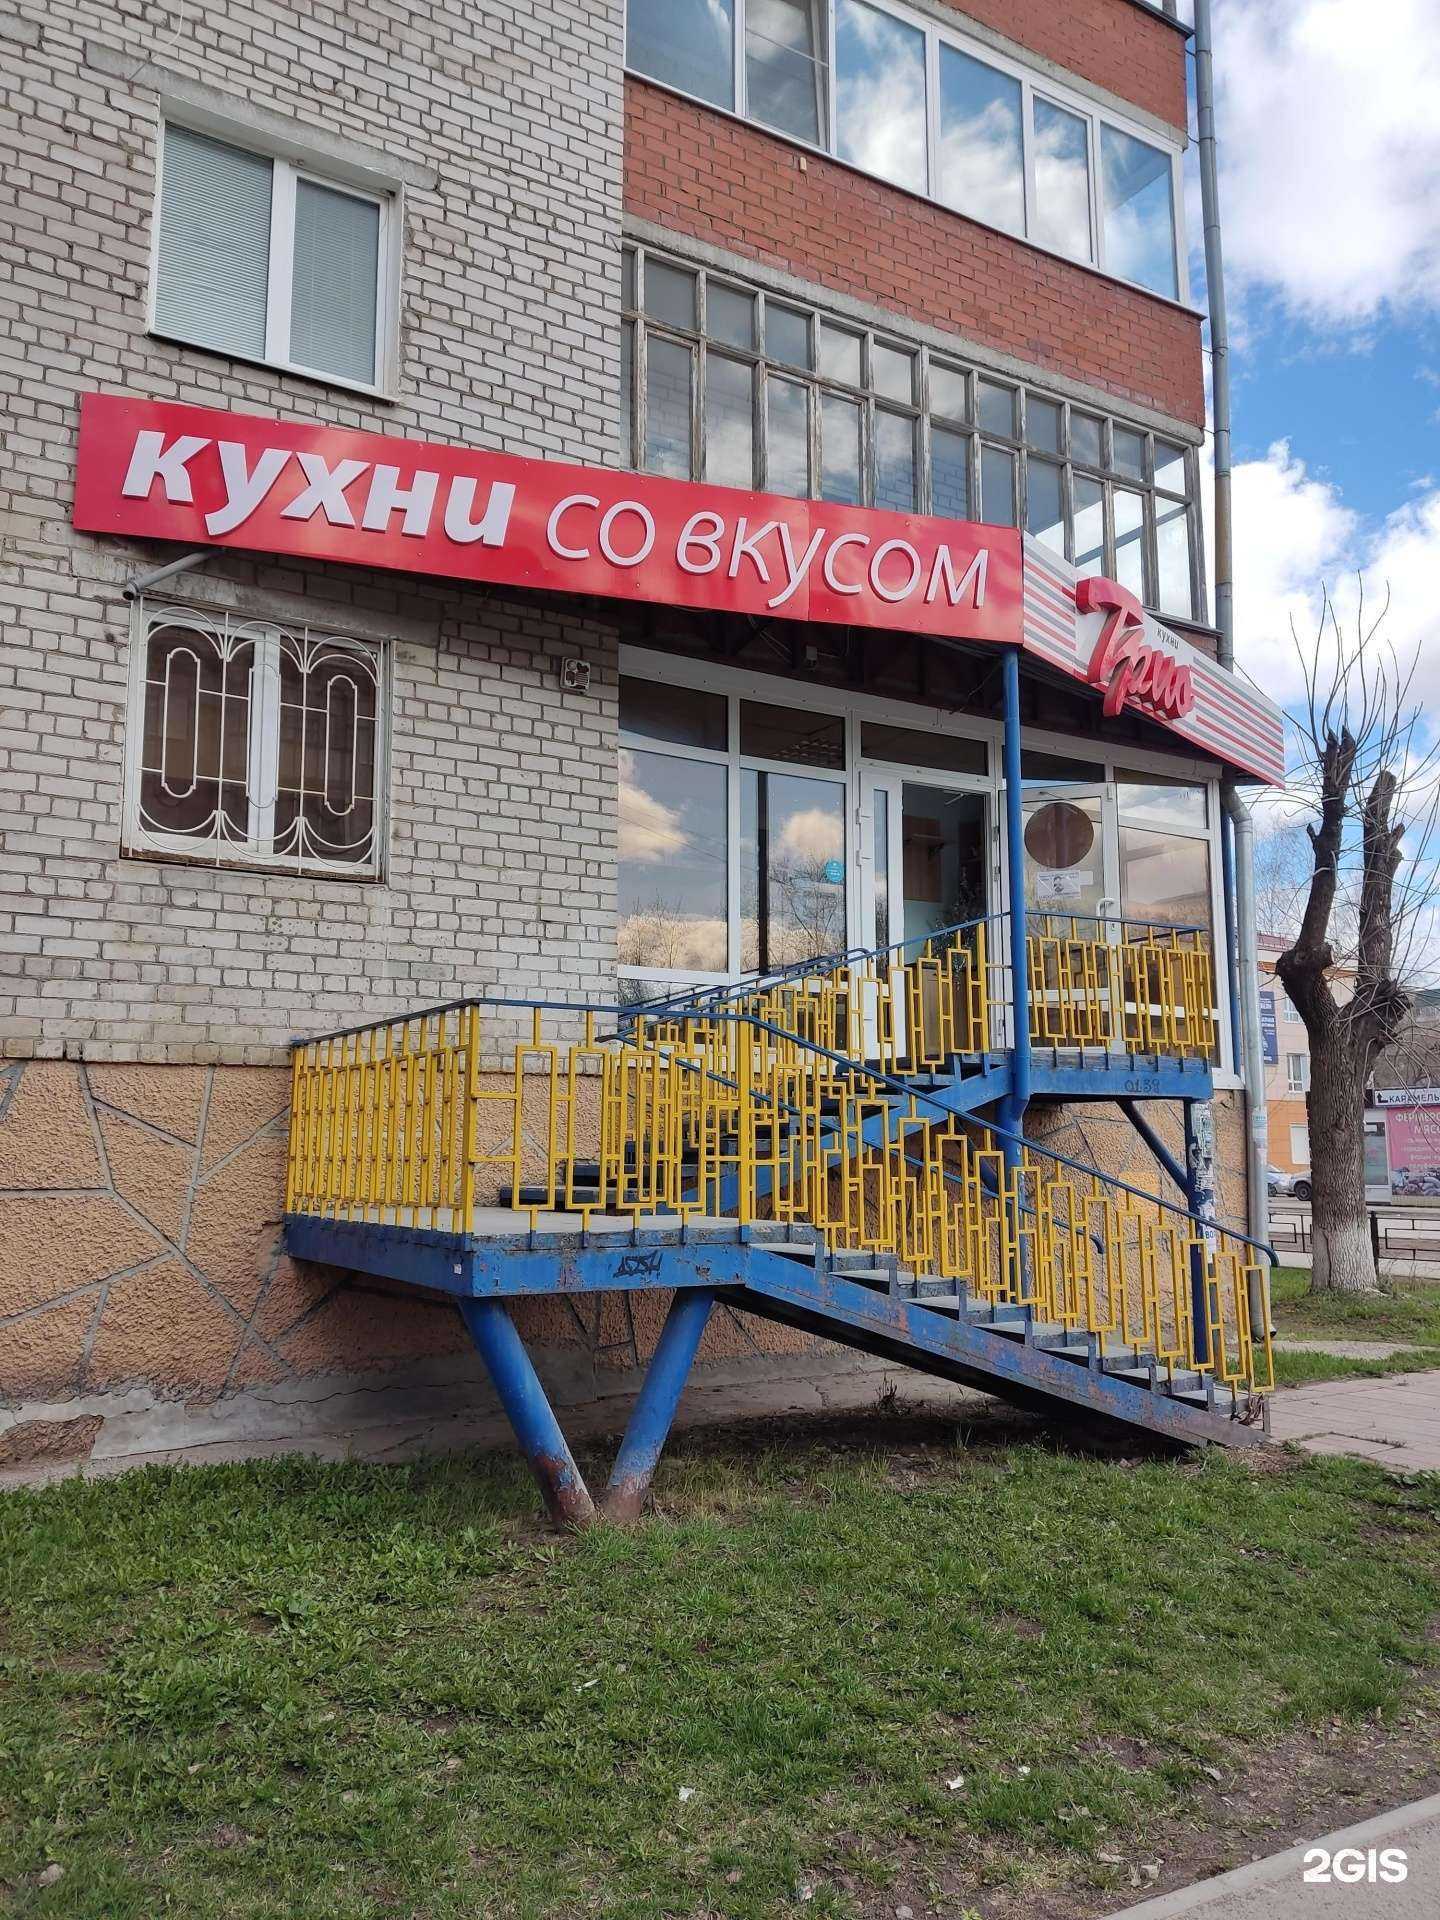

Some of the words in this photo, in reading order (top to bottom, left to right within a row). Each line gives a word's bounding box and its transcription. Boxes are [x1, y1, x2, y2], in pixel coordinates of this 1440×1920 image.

[122, 429, 517, 547] кухни
[546, 494, 656, 568] со
[675, 510, 990, 609] вкусом
